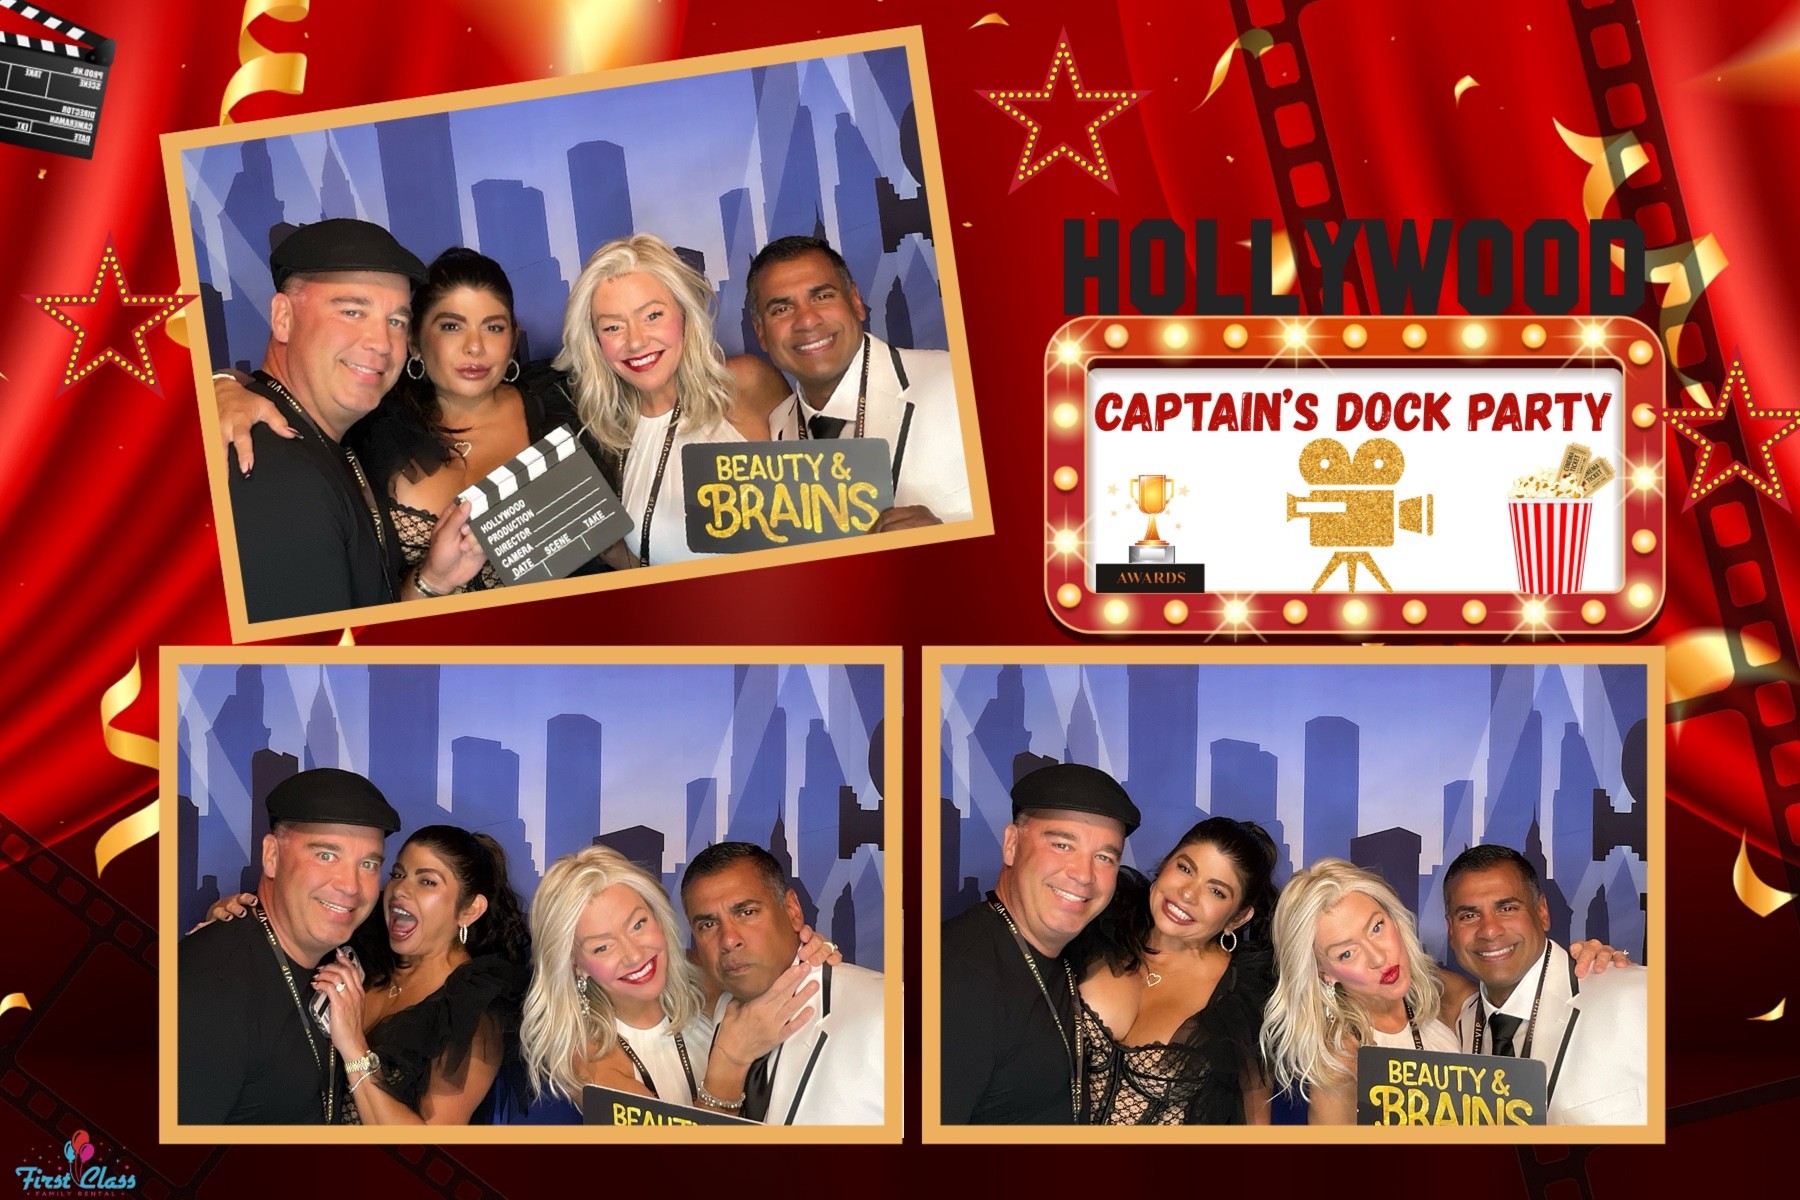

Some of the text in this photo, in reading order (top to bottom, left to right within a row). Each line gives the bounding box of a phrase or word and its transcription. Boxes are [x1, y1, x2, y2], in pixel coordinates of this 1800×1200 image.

[715, 452, 852, 482] BEAUTY &
[480, 499, 526, 534] HOLLYWOOD
[487, 509, 535, 546] PRODUCTION
[697, 481, 880, 544] BRAINS
[494, 527, 533, 557] DIRECTOR
[501, 543, 534, 568] CAMERA
[511, 510, 606, 578] DATE SCENE TAKE
[281, 965, 293, 983] VIP
[1388, 1059, 1511, 1097] BEAUTY &
[1369, 1085, 1533, 1126] BRAINS
